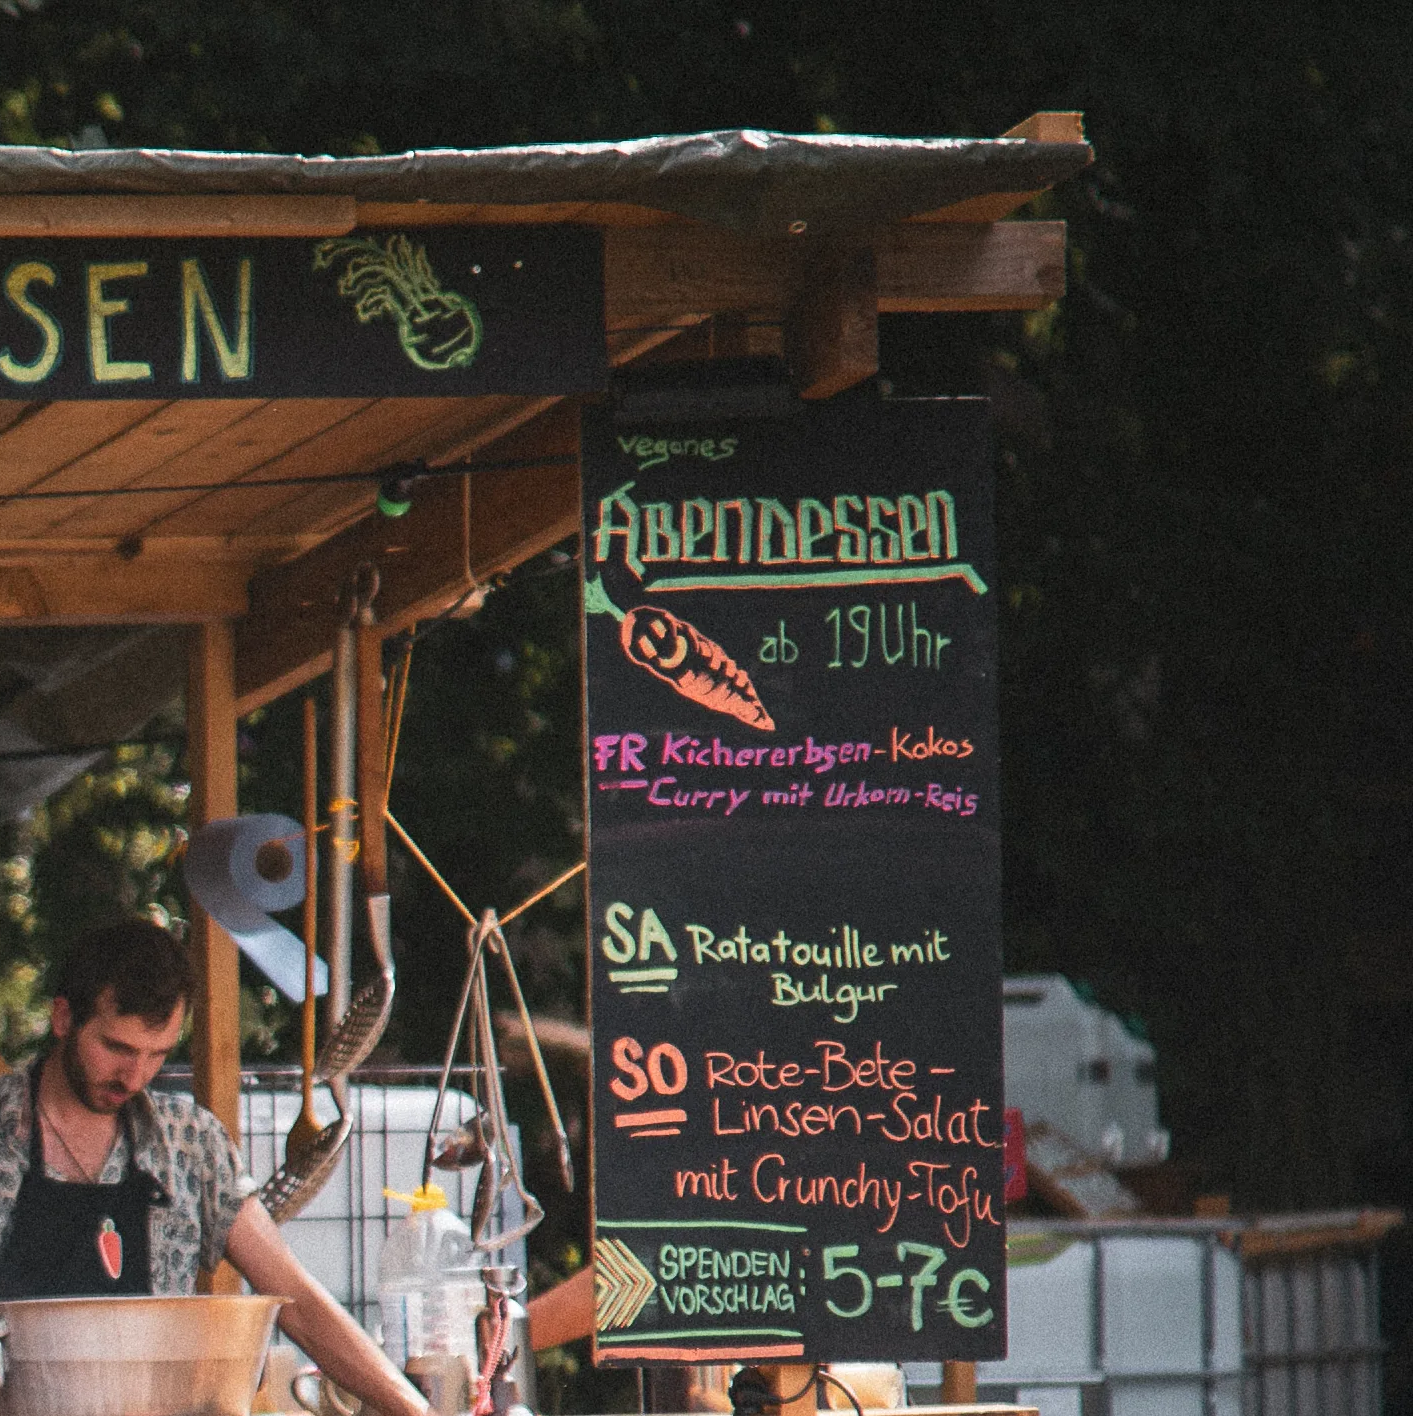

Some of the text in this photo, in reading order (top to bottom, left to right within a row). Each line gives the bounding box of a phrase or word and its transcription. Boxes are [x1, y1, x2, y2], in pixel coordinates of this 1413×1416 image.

[759, 620, 799, 663] ab
[593, 733, 648, 771] FR
[647, 777, 751, 816] Curry
[762, 784, 814, 807] mit
[602, 902, 951, 969] SA Ratatouille mit
[771, 973, 898, 1023] Bulgur
[609, 1037, 688, 1100] SO
[713, 1092, 1007, 1148] Linsen-Salat
[676, 1153, 1001, 1248] mit Crunchy-Tofu
[659, 1244, 791, 1281] SPENDEN
